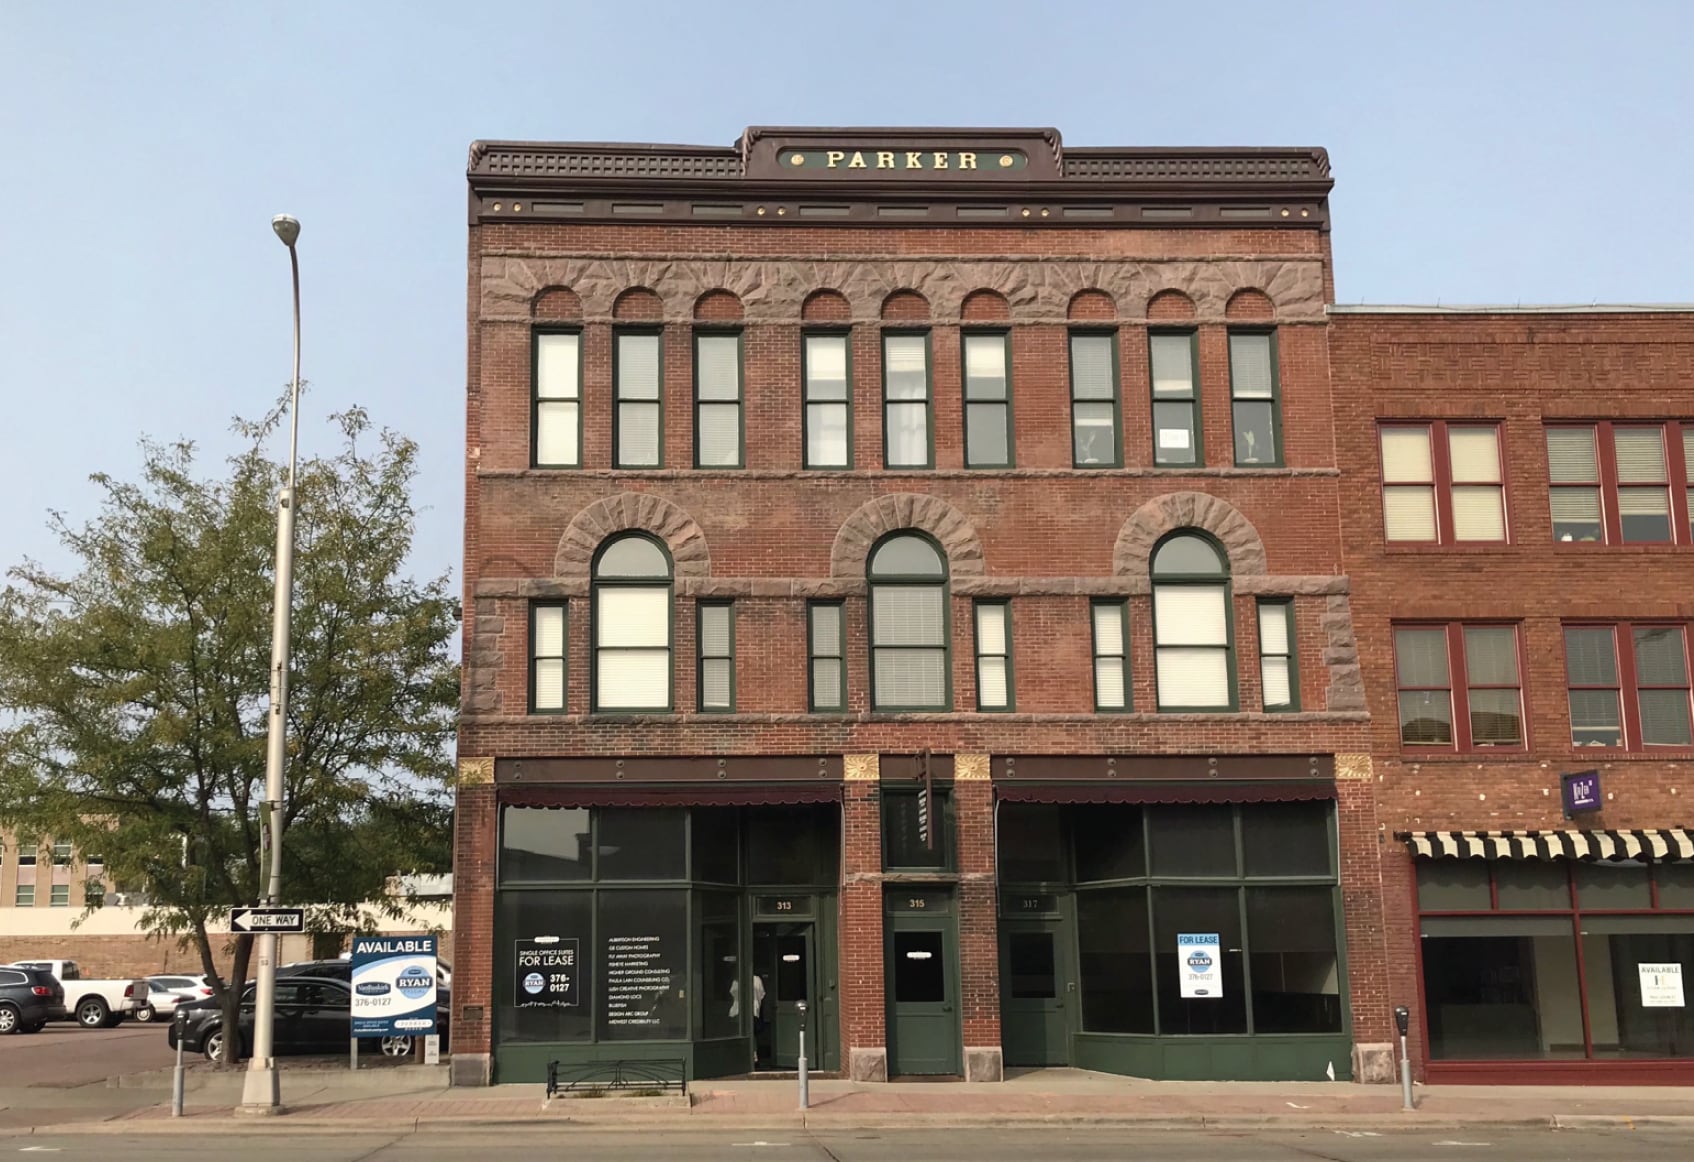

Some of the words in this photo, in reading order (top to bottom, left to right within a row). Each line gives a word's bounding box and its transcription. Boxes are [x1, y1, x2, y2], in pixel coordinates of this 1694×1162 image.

[826, 151, 977, 169] PARKER
[777, 901, 792, 910] 313
[909, 899, 925, 908] 315
[1023, 899, 1038, 909] 317
[252, 915, 272, 925] ONE
[275, 915, 296, 925] WAY
[1179, 936, 1194, 944] FOR
[1195, 936, 1218, 944] LEASE
[356, 940, 432, 954] AVAILABLE
[519, 956, 541, 966] FOR
[543, 955, 574, 966] LEASE
[399, 978, 430, 987] RYAN
[550, 983, 570, 992] 0127
[355, 998, 391, 1007] 376-0127
